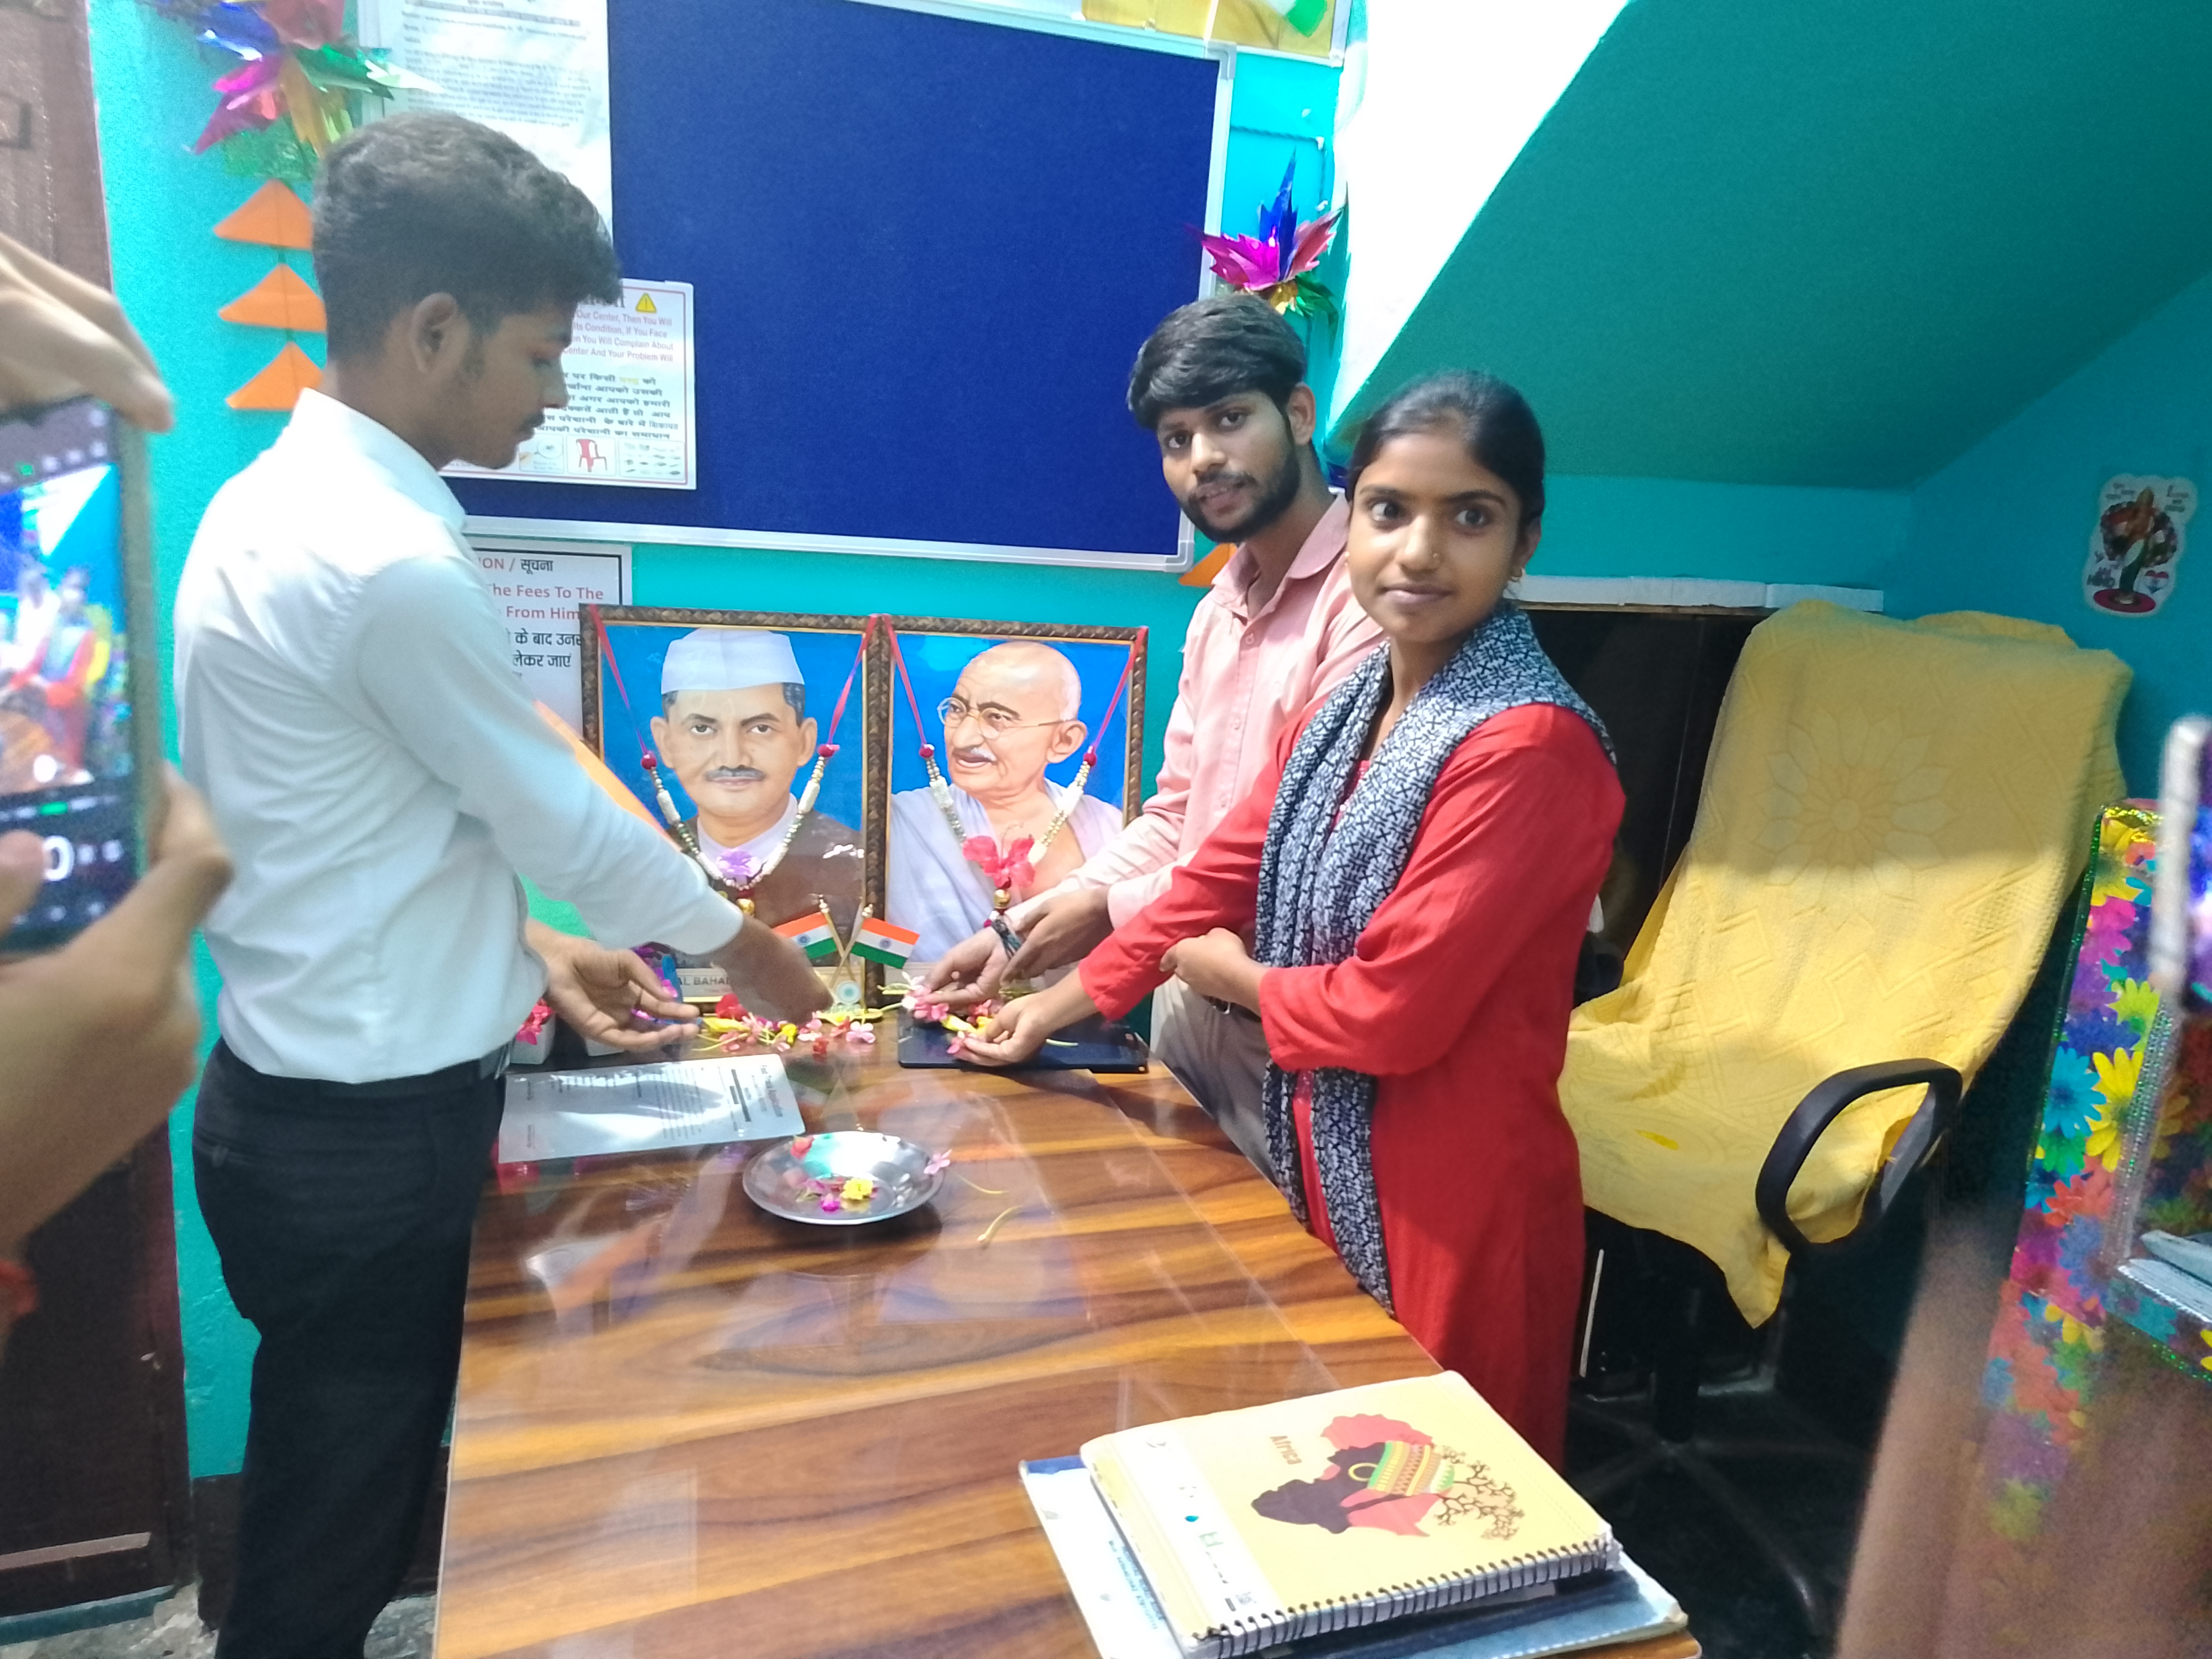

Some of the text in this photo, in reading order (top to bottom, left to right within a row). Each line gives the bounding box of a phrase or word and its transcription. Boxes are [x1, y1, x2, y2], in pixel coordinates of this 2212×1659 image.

[576, 310, 672, 326] Our Center, Then You Will
[625, 326, 632, 335] If
[633, 327, 648, 337] You
[649, 328, 667, 338] Face
[582, 334, 597, 344] You
[599, 336, 613, 345] Will
[614, 337, 649, 348] Complain
[651, 341, 673, 350] About
[591, 347, 606, 357] And
[608, 349, 624, 358] Your
[627, 350, 658, 361] Problem
[660, 353, 673, 362] Will
[589, 373, 615, 382] किसी
[607, 397, 639, 406] आपको
[604, 416, 614, 425] के
[649, 420, 679, 430] शिकायत
[520, 558, 554, 575] सूचना
[517, 585, 550, 598] Fees
[555, 586, 572, 599] To
[576, 587, 604, 600] The
[506, 606, 545, 619] From
[514, 628, 529, 644] के
[531, 632, 552, 645] बाद
[512, 650, 544, 667] लेकर
[1270, 1436, 1302, 1465] Africa
